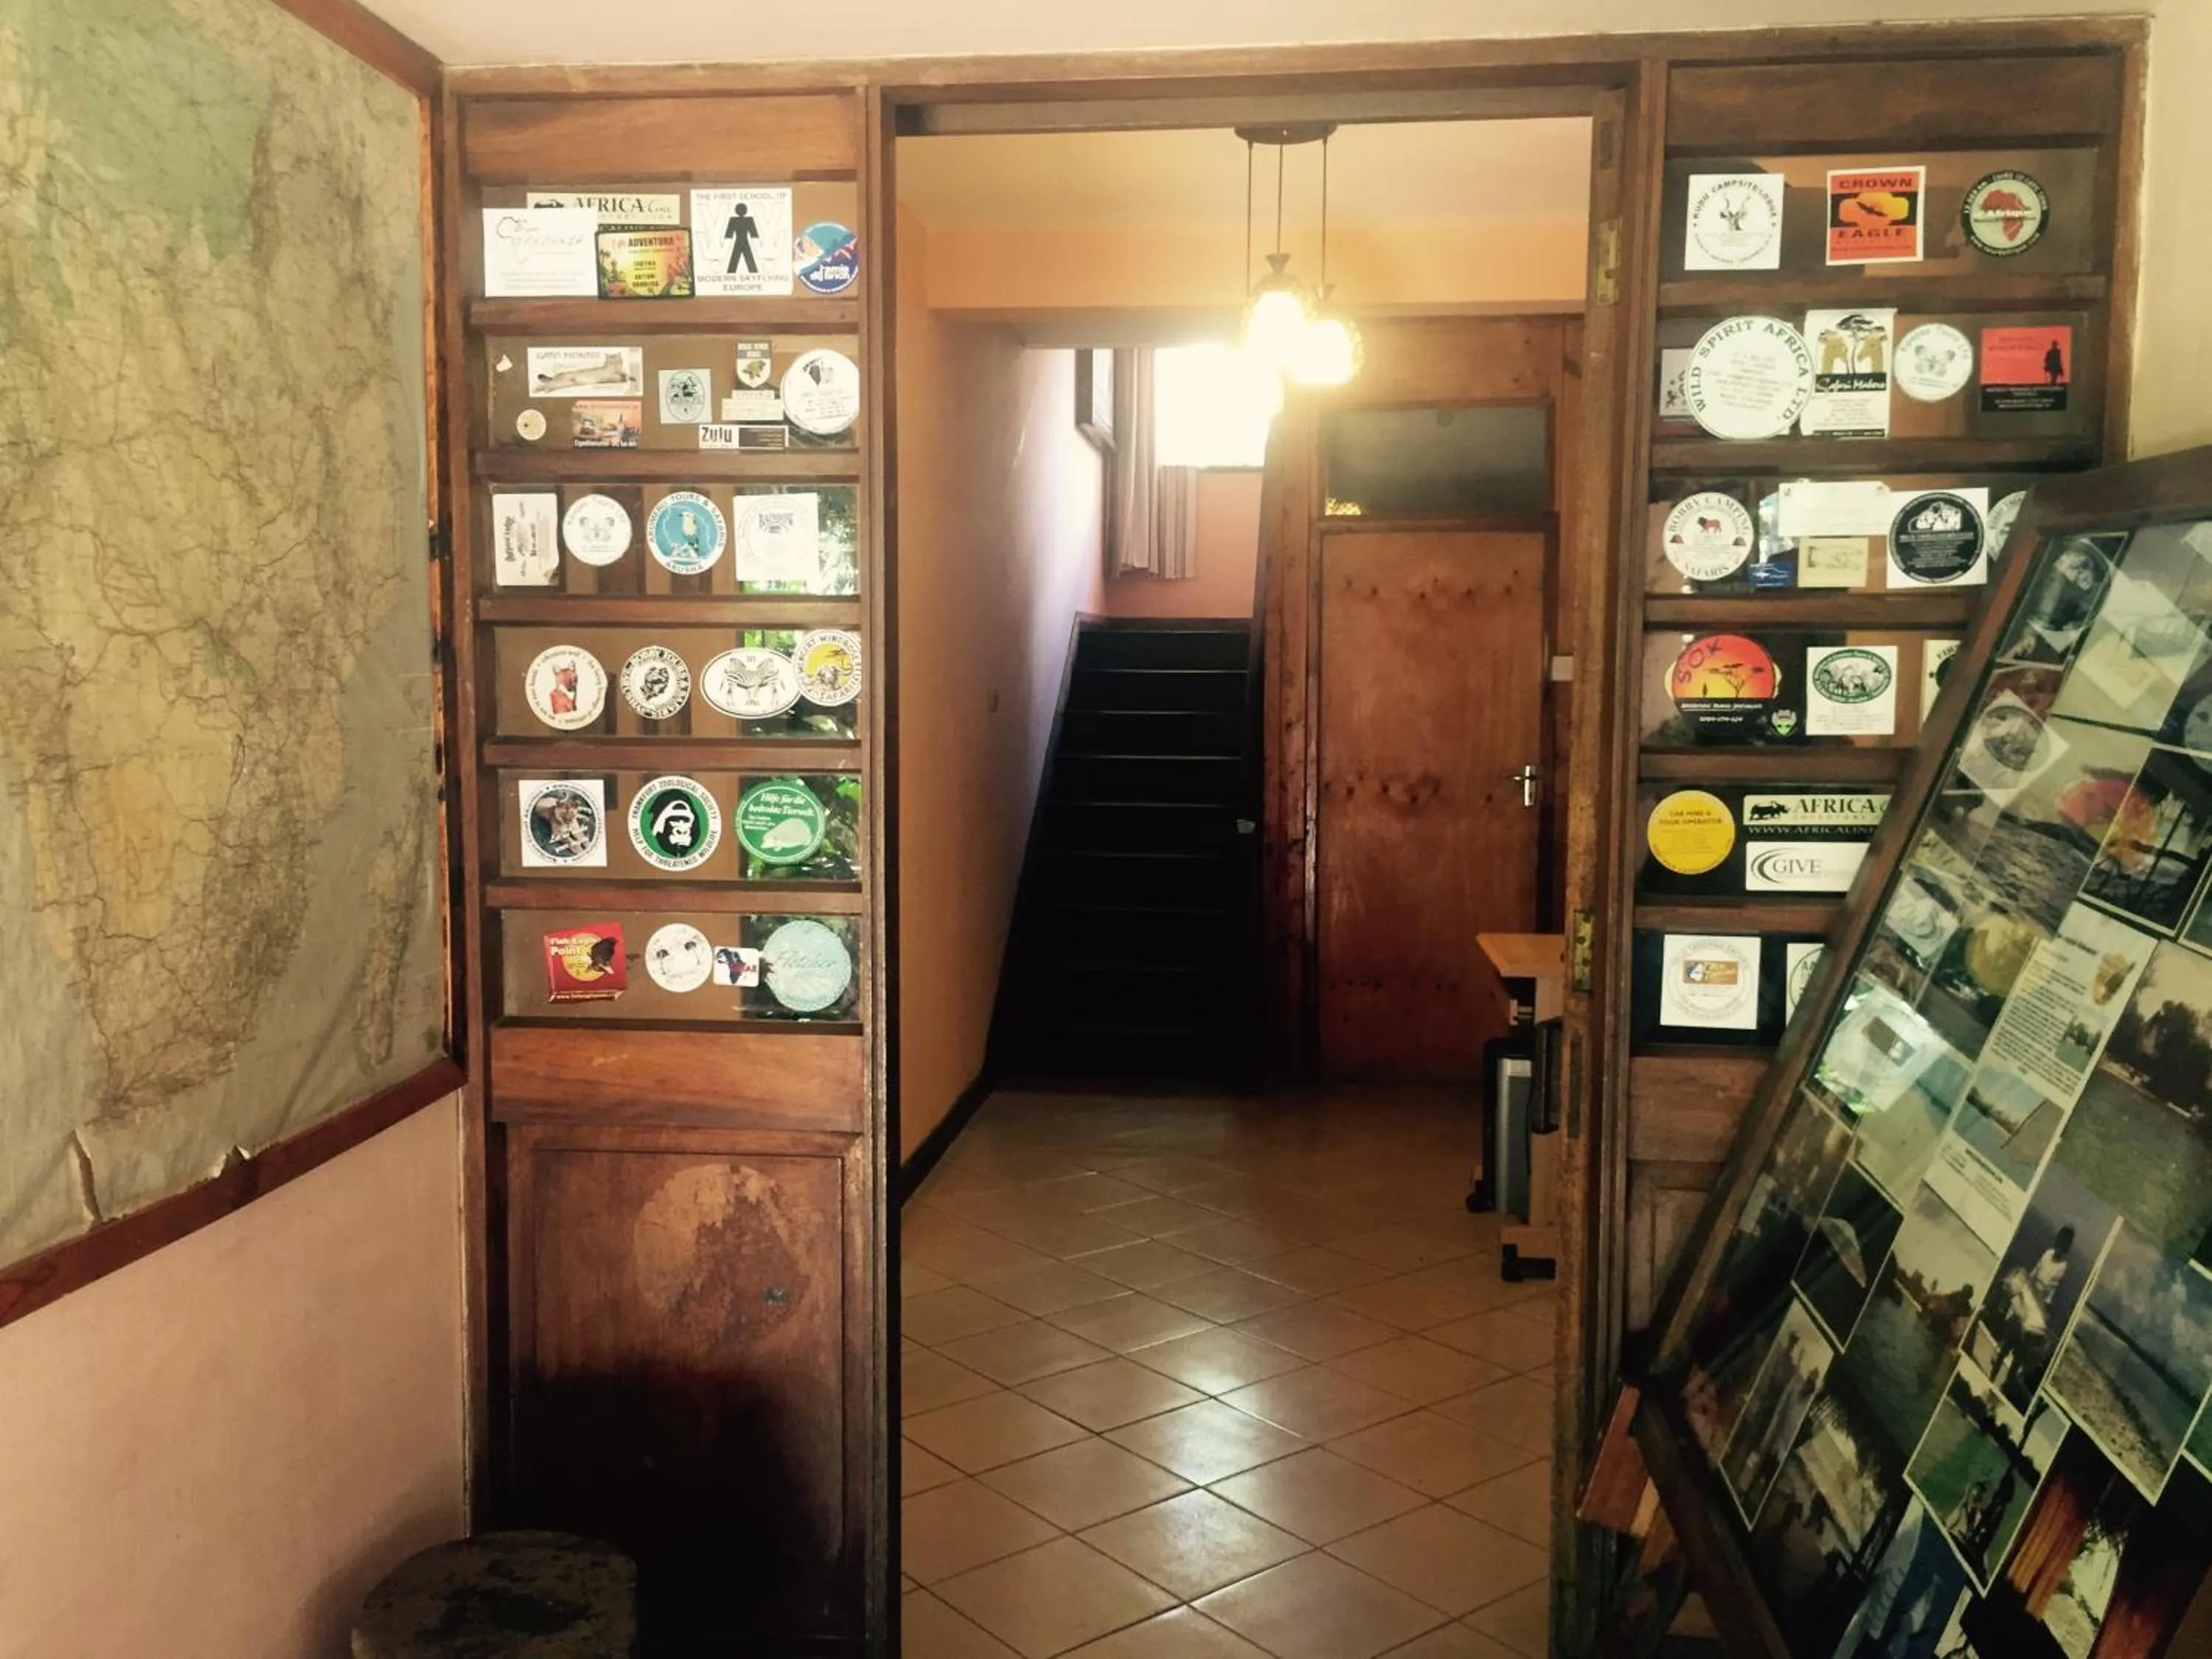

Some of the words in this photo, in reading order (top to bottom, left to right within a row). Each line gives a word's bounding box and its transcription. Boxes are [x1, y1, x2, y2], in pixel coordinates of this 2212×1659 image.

[1840, 178, 1912, 189] CROWN
[573, 197, 644, 213] AFRICA
[1838, 228, 1906, 239] EAGLE
[1689, 366, 1706, 413] WILD
[1698, 319, 1755, 359] SPIRIT
[1762, 321, 1810, 378] AFRICA
[1794, 799, 1877, 813] AFRICA
[1773, 859, 1822, 874] GIVE
[550, 946, 582, 956] Point
